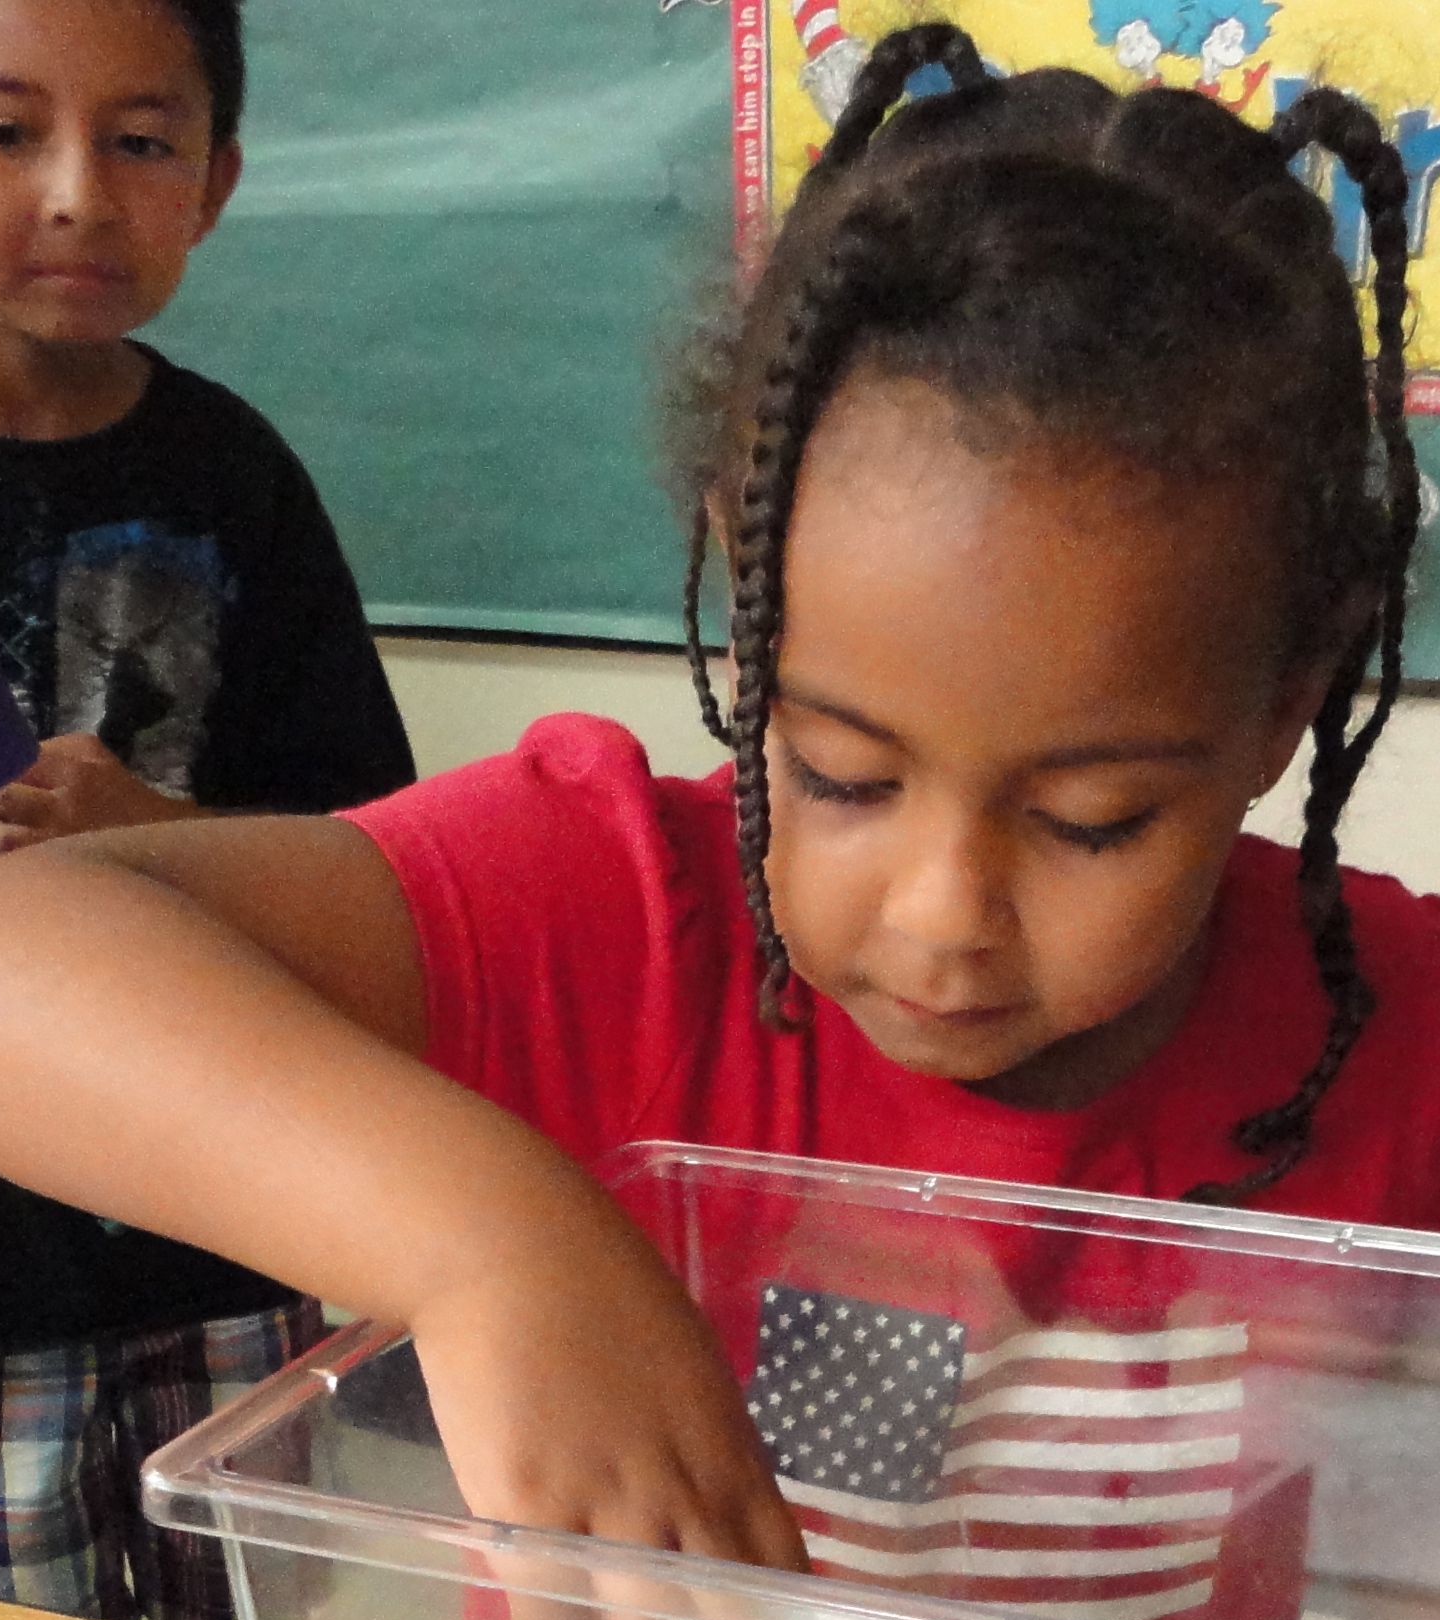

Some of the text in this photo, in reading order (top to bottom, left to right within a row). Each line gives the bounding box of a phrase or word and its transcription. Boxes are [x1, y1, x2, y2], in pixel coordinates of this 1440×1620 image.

[738, 5, 757, 28] in
[736, 90, 758, 131] him
[744, 138, 758, 178] saw
